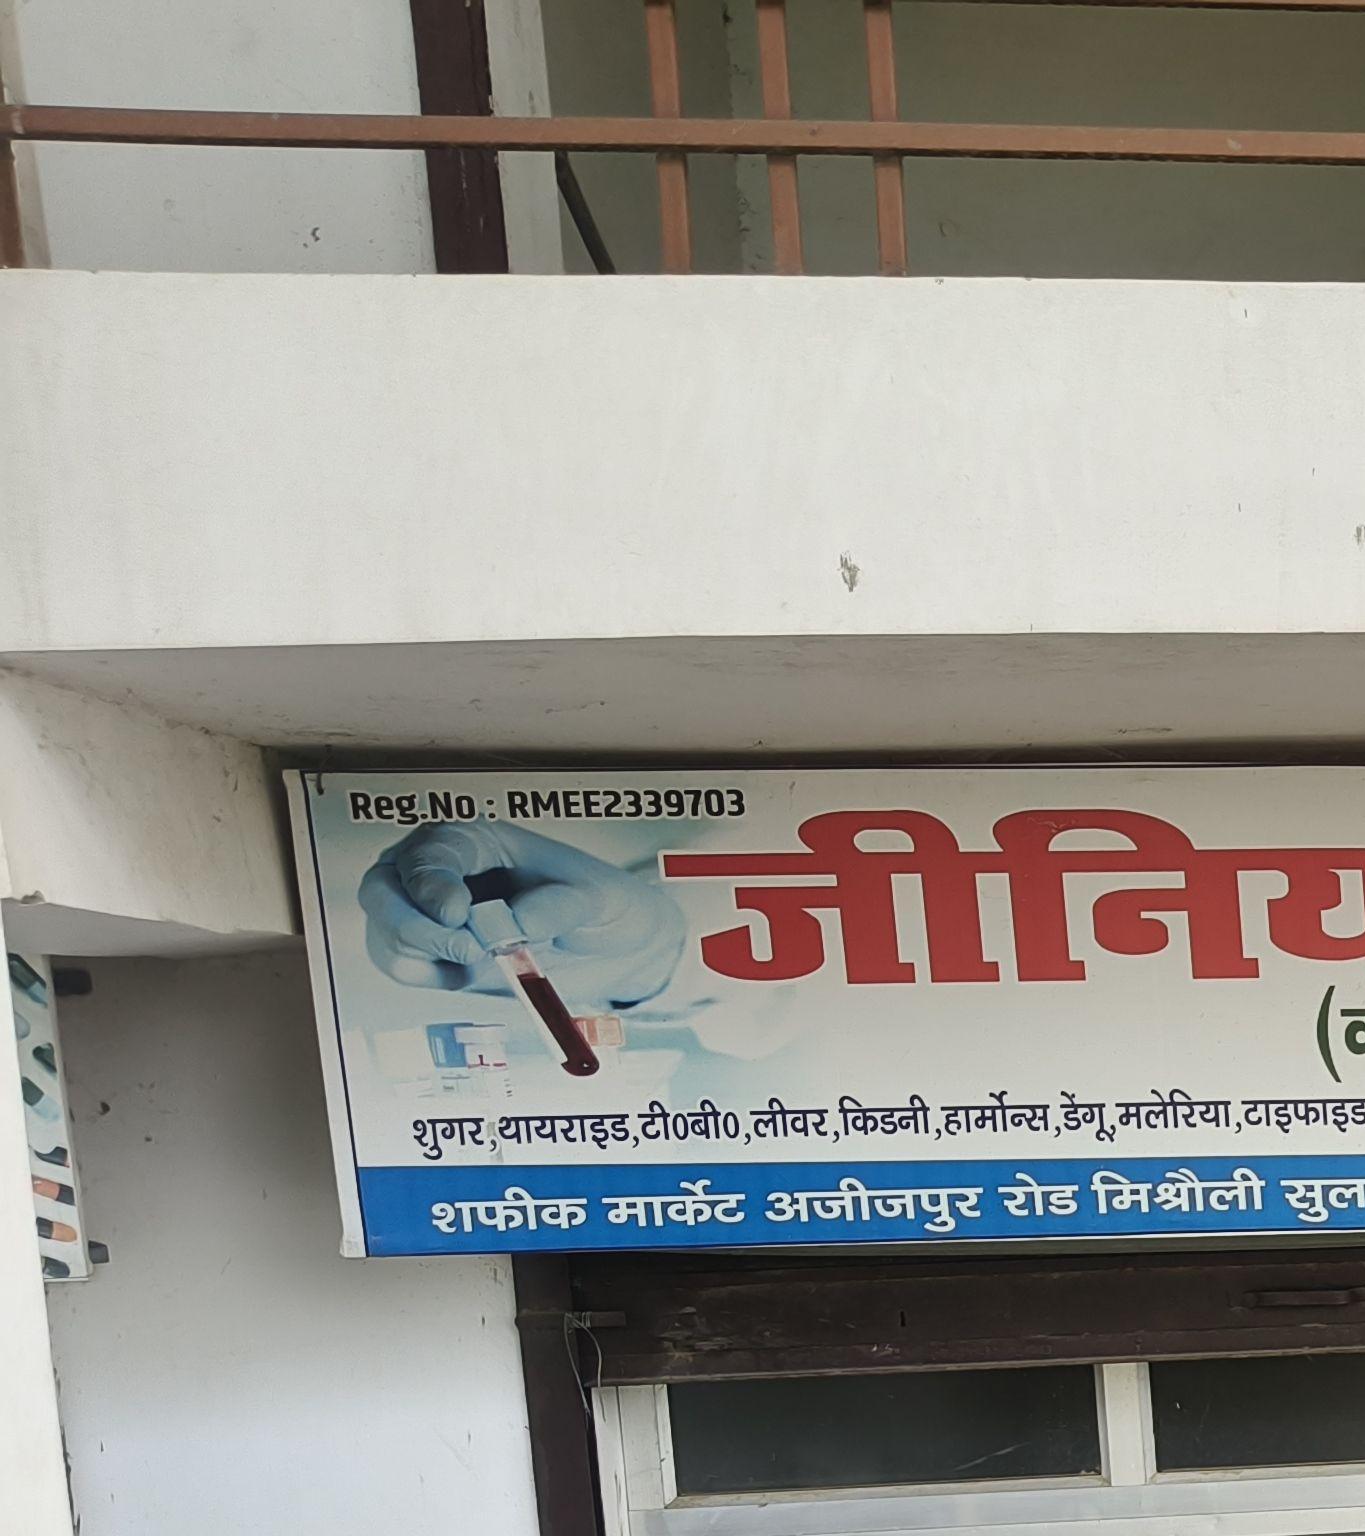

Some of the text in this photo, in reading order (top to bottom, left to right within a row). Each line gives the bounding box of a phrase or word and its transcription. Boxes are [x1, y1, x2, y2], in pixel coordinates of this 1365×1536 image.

[507, 789, 746, 819] RMEE2339703
[432, 1186, 588, 1234] शफीक
[602, 1179, 746, 1228] मार्केट
[765, 1177, 983, 1233] अजीजपुर
[998, 1172, 1079, 1217] रोड
[1091, 1167, 1266, 1215] मिश्रौली
